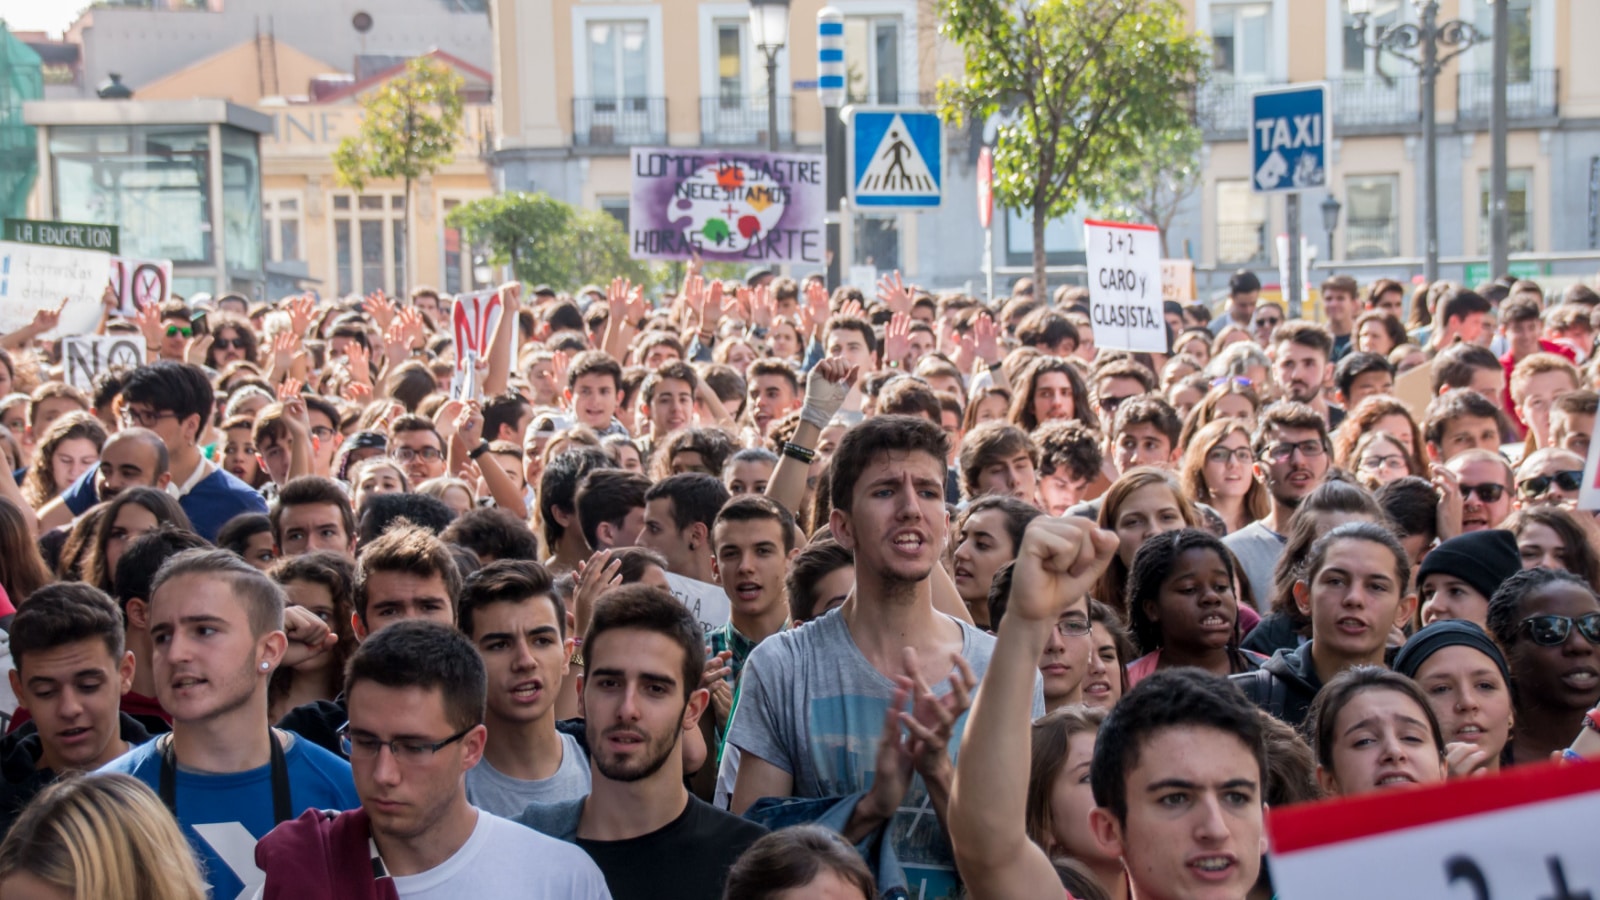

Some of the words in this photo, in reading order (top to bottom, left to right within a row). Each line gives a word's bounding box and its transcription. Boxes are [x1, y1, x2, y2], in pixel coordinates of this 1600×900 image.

[1255, 113, 1322, 152] TAXI
[719, 157, 821, 185] DESASTRE
[675, 182, 792, 205] NECESITAMOS
[16, 223, 33, 242] LA
[634, 229, 704, 255] HORAS
[716, 231, 737, 248] DE
[743, 229, 821, 263] ARTE
[1099, 267, 1136, 291] CARO
[1093, 303, 1159, 328] CLASISTA.
